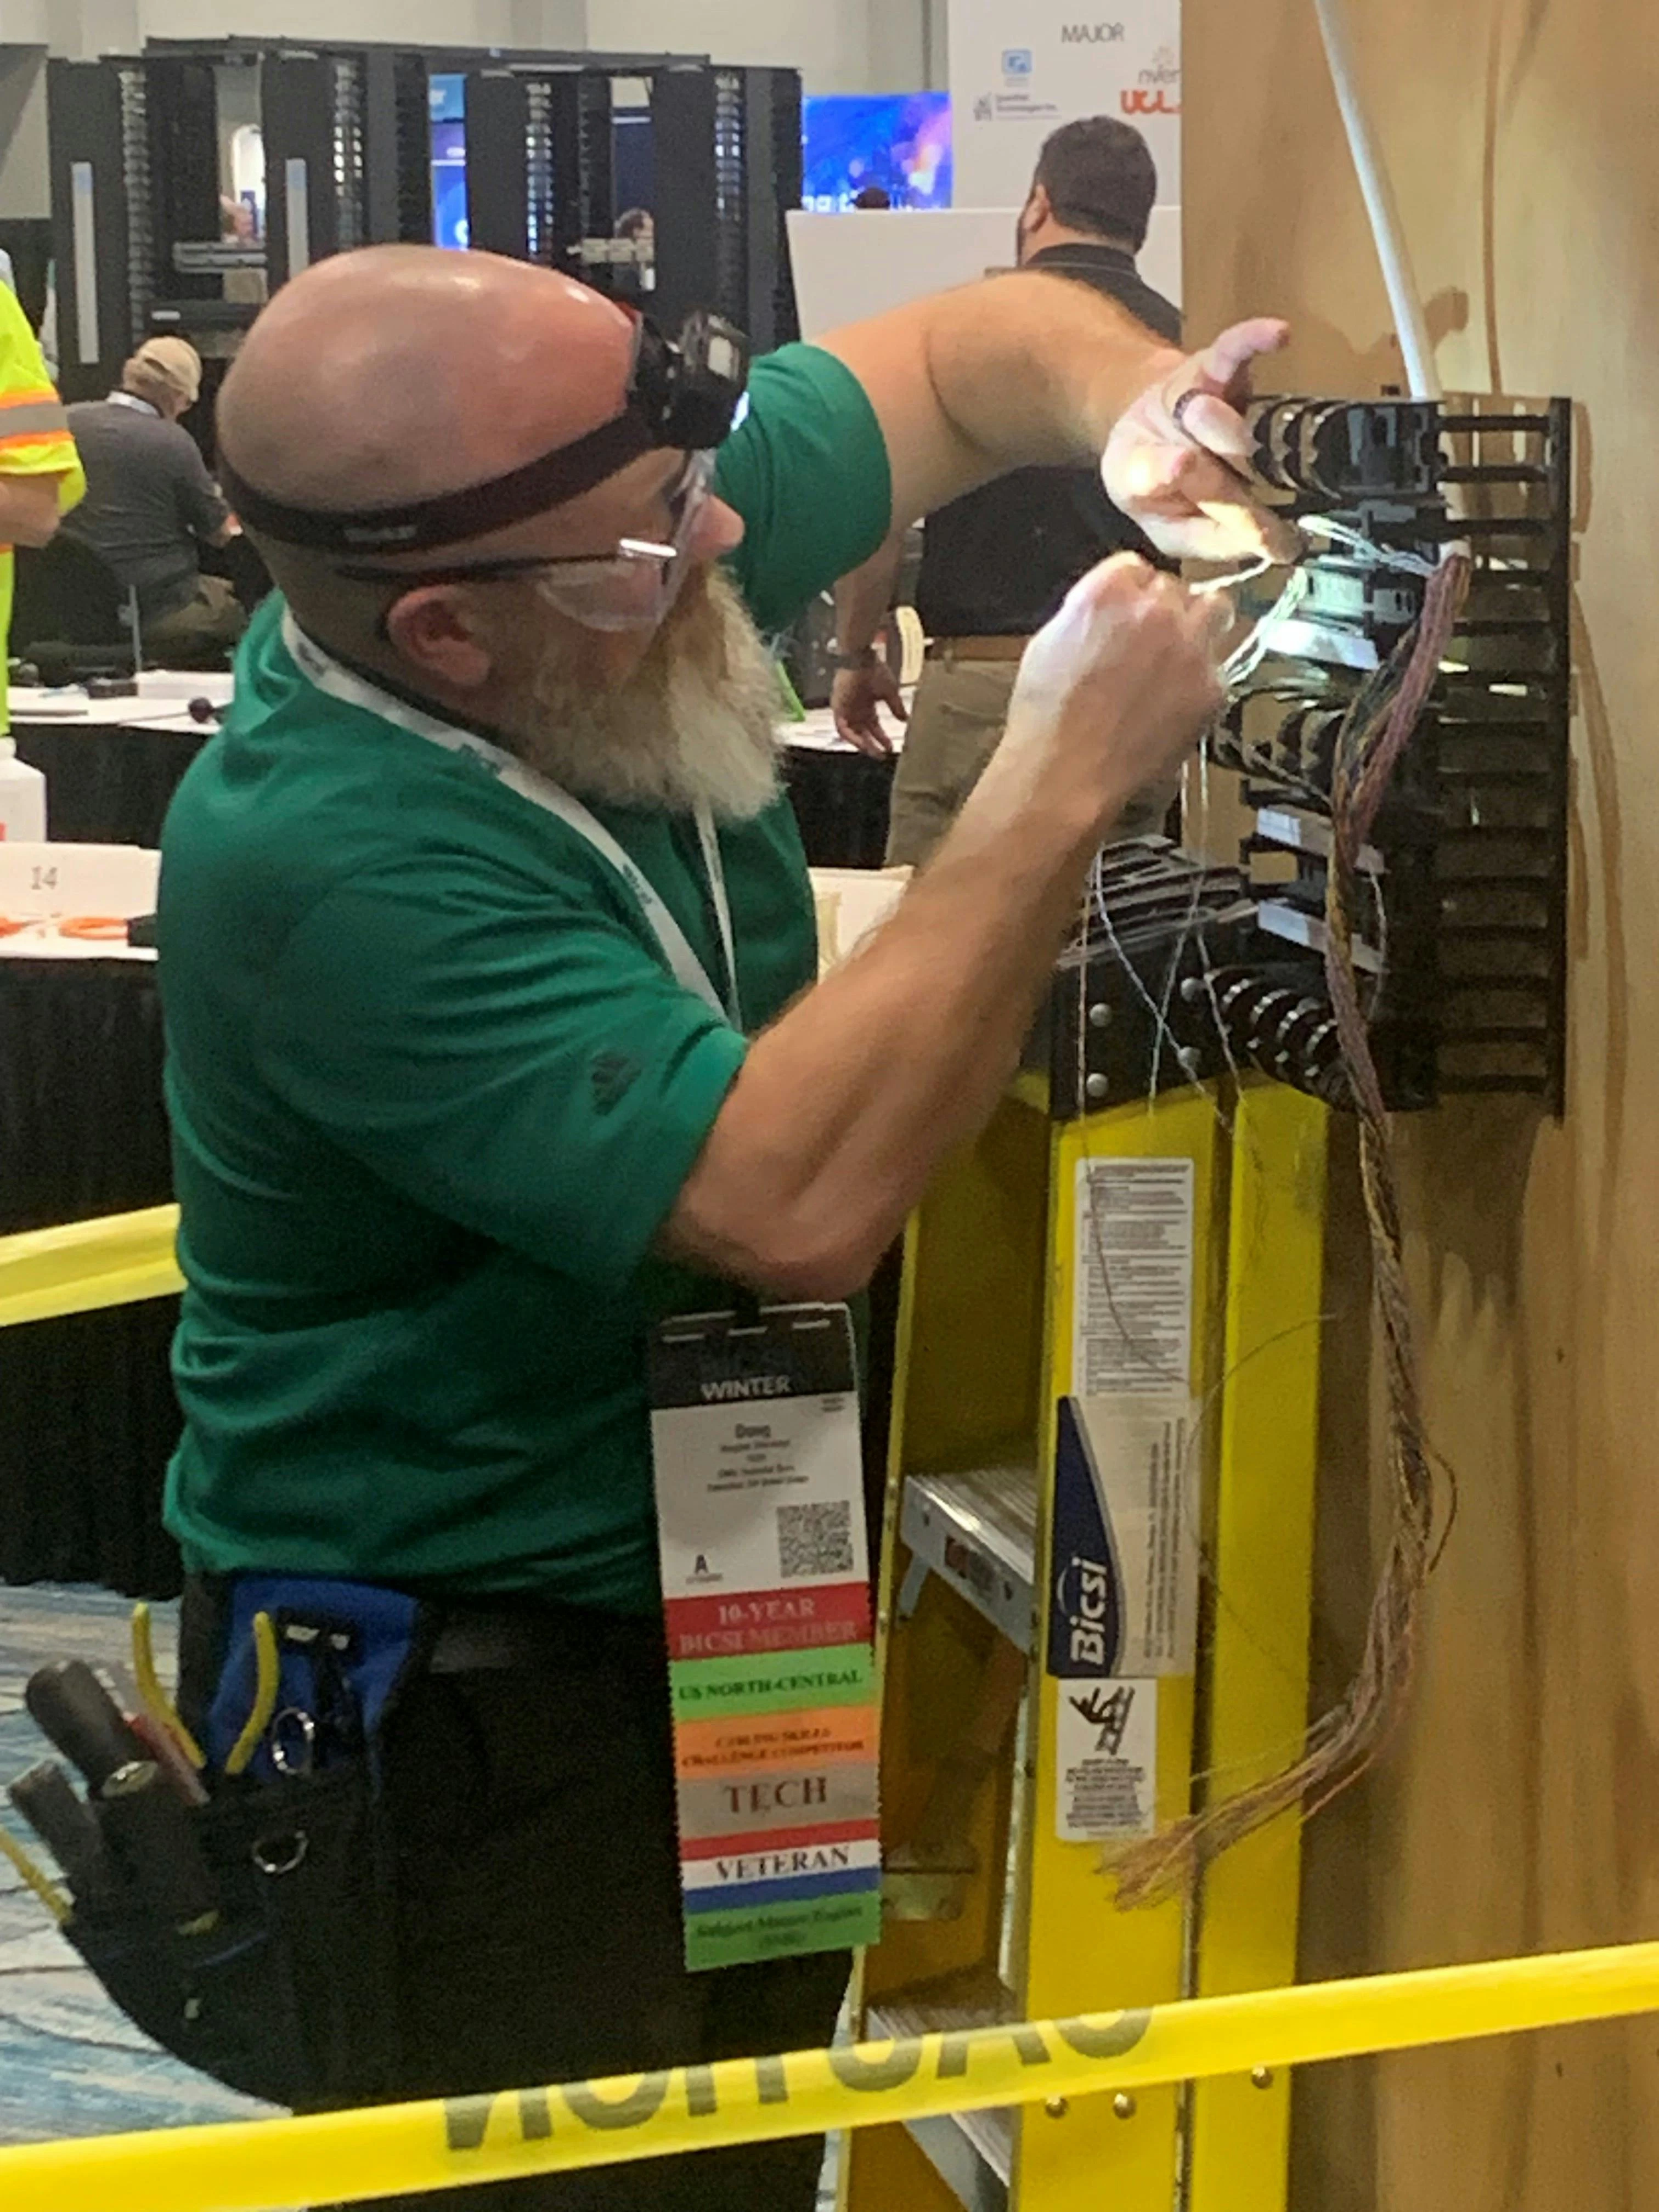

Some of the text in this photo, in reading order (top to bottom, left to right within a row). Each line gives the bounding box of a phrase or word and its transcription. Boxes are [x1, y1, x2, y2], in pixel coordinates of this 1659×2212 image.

[1062, 23, 1124, 43] MAJOR
[31, 866, 58, 890] 14
[701, 1375, 791, 1401] WINTER
[695, 1554, 709, 1575] A
[719, 1598, 815, 1626] 10-YEAR
[679, 1685, 702, 1700] US
[723, 1776, 827, 1813] TECH
[715, 1846, 849, 1881] VETERAN
